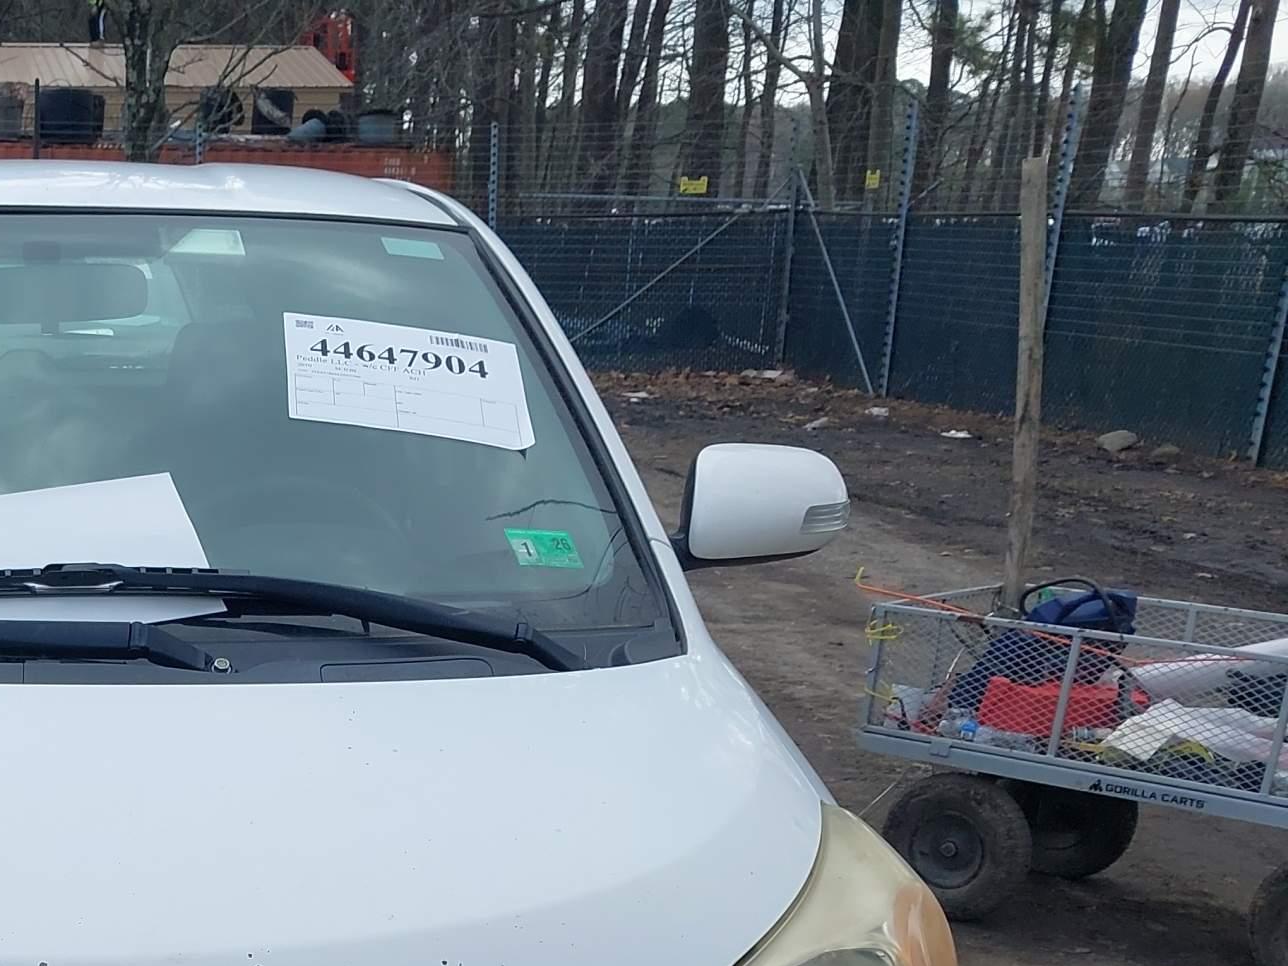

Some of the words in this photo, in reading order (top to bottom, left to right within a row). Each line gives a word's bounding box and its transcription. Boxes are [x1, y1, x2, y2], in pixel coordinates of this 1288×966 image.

[296, 354, 328, 363] Peddle
[309, 338, 489, 379] 44647904
[520, 541, 532, 557] 1
[1105, 784, 1157, 800] GORILLA
[1161, 793, 1206, 809] CARTS
